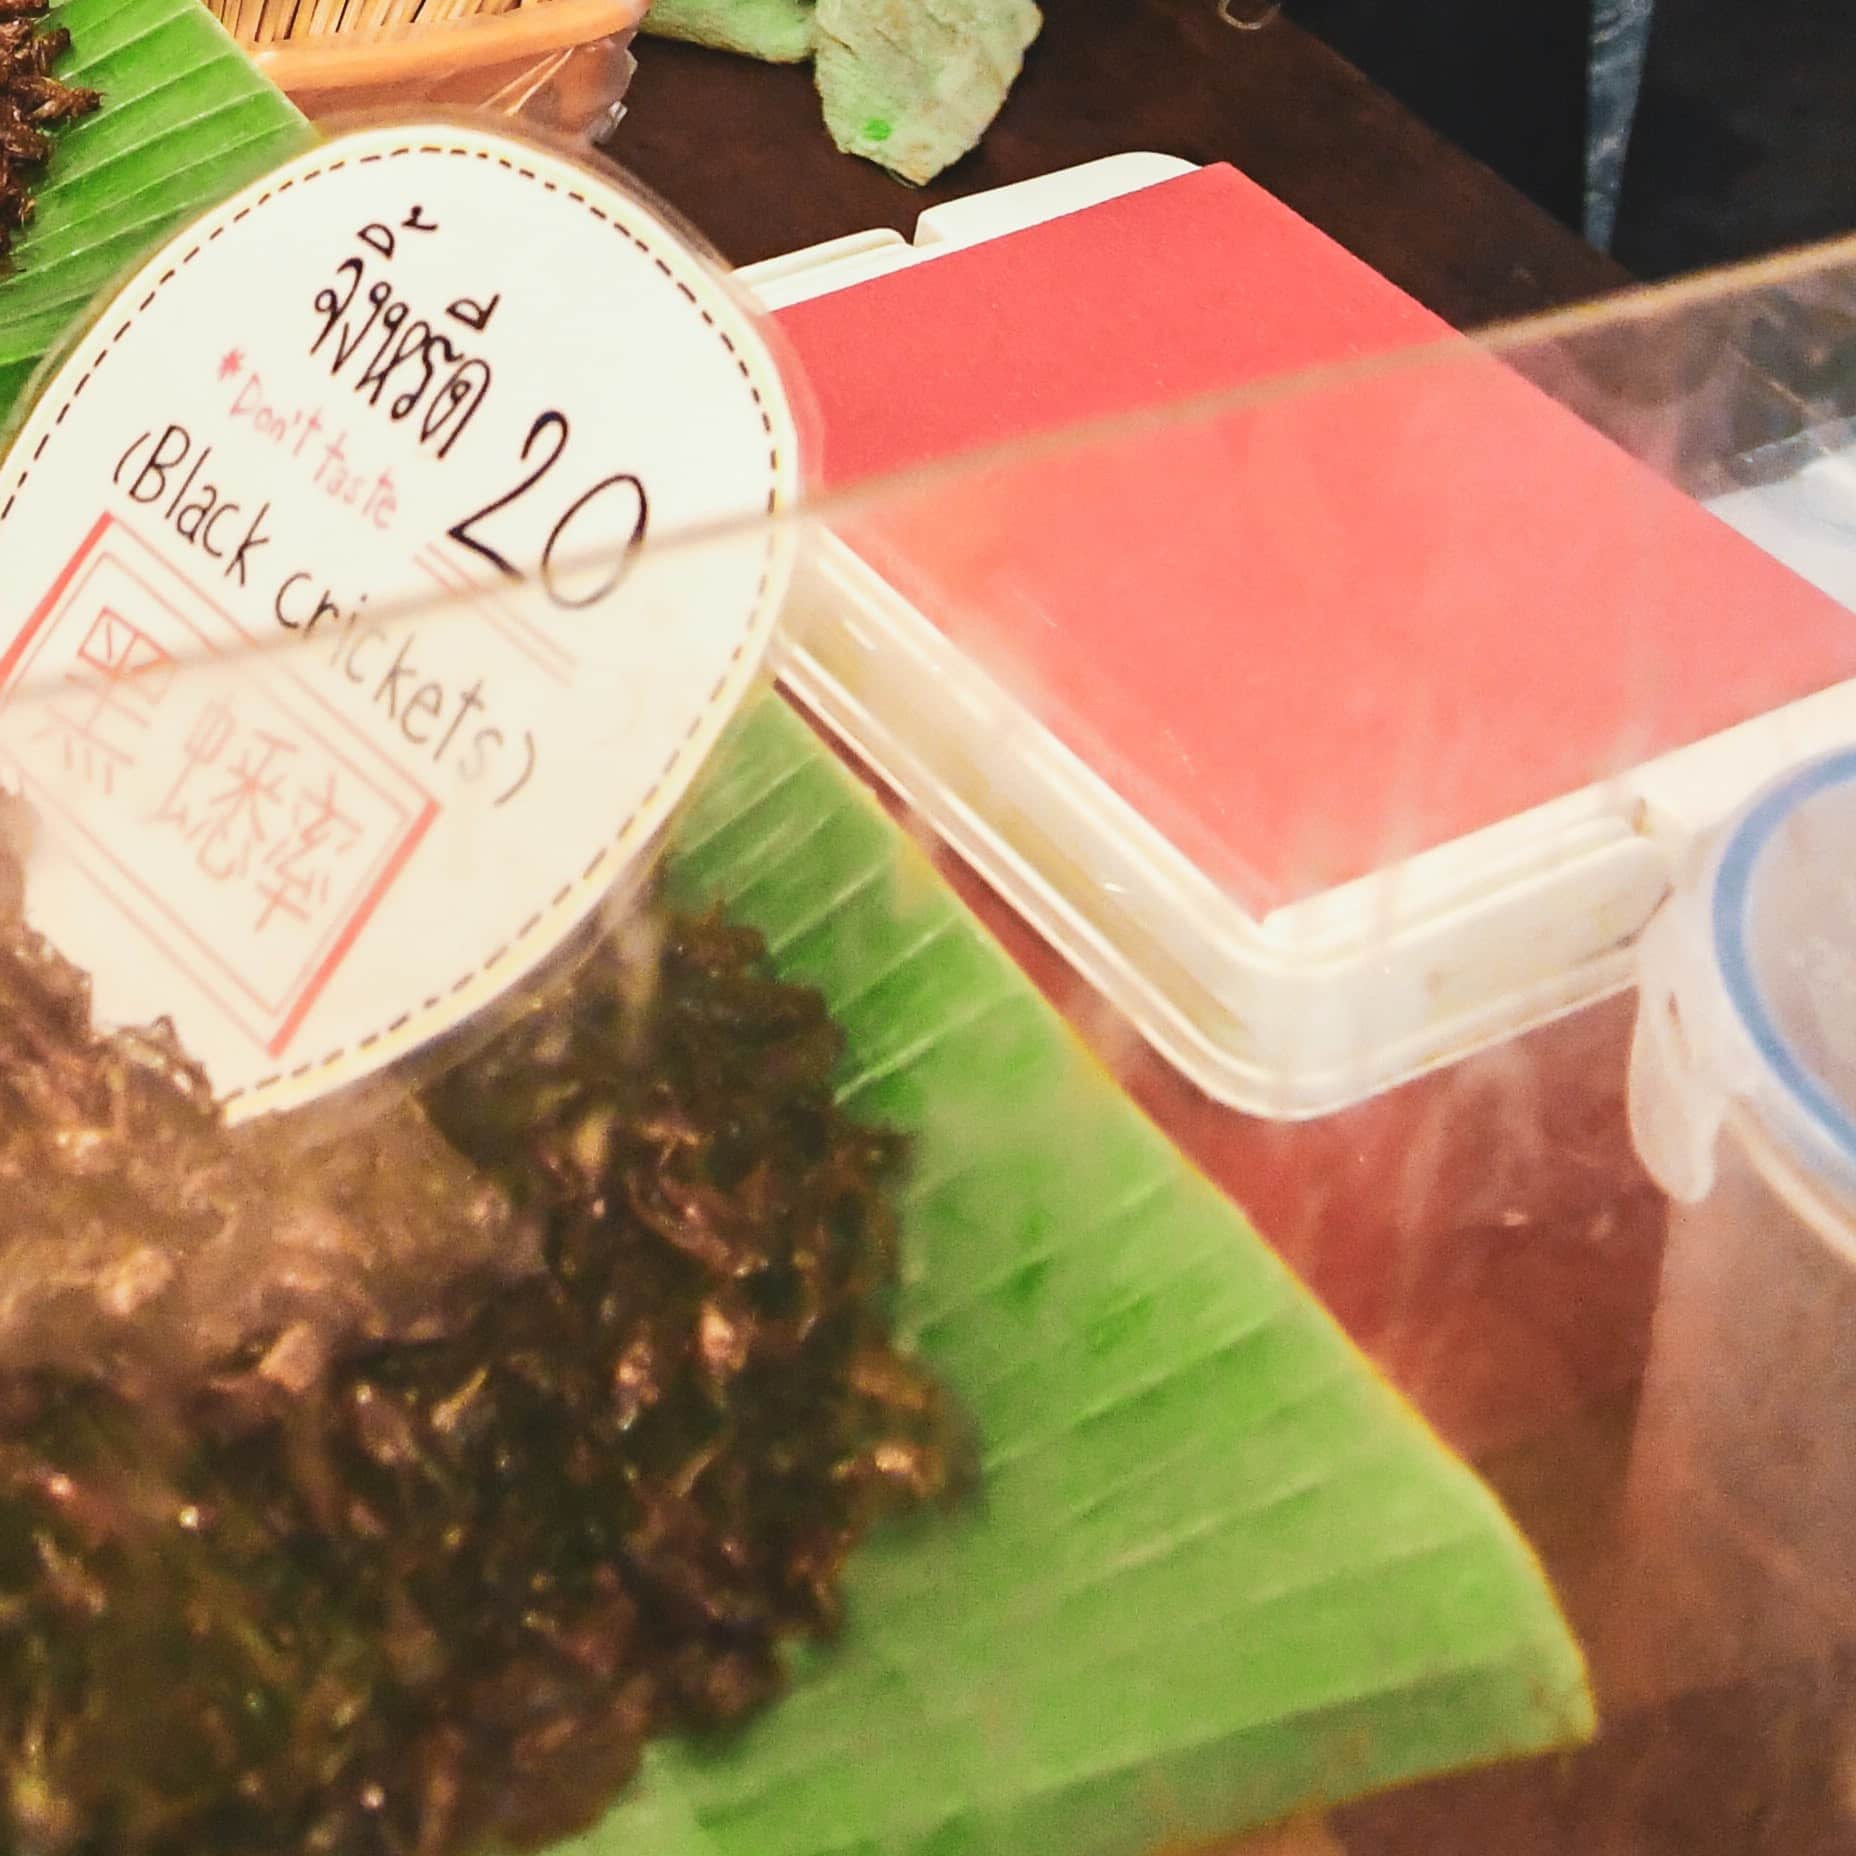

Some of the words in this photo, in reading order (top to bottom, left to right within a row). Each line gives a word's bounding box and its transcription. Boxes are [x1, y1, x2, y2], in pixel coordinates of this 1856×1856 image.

[312, 430, 399, 529] taste
[446, 409, 650, 610] 20
[112, 422, 271, 588] (Black
[273, 570, 537, 808] crickets)
